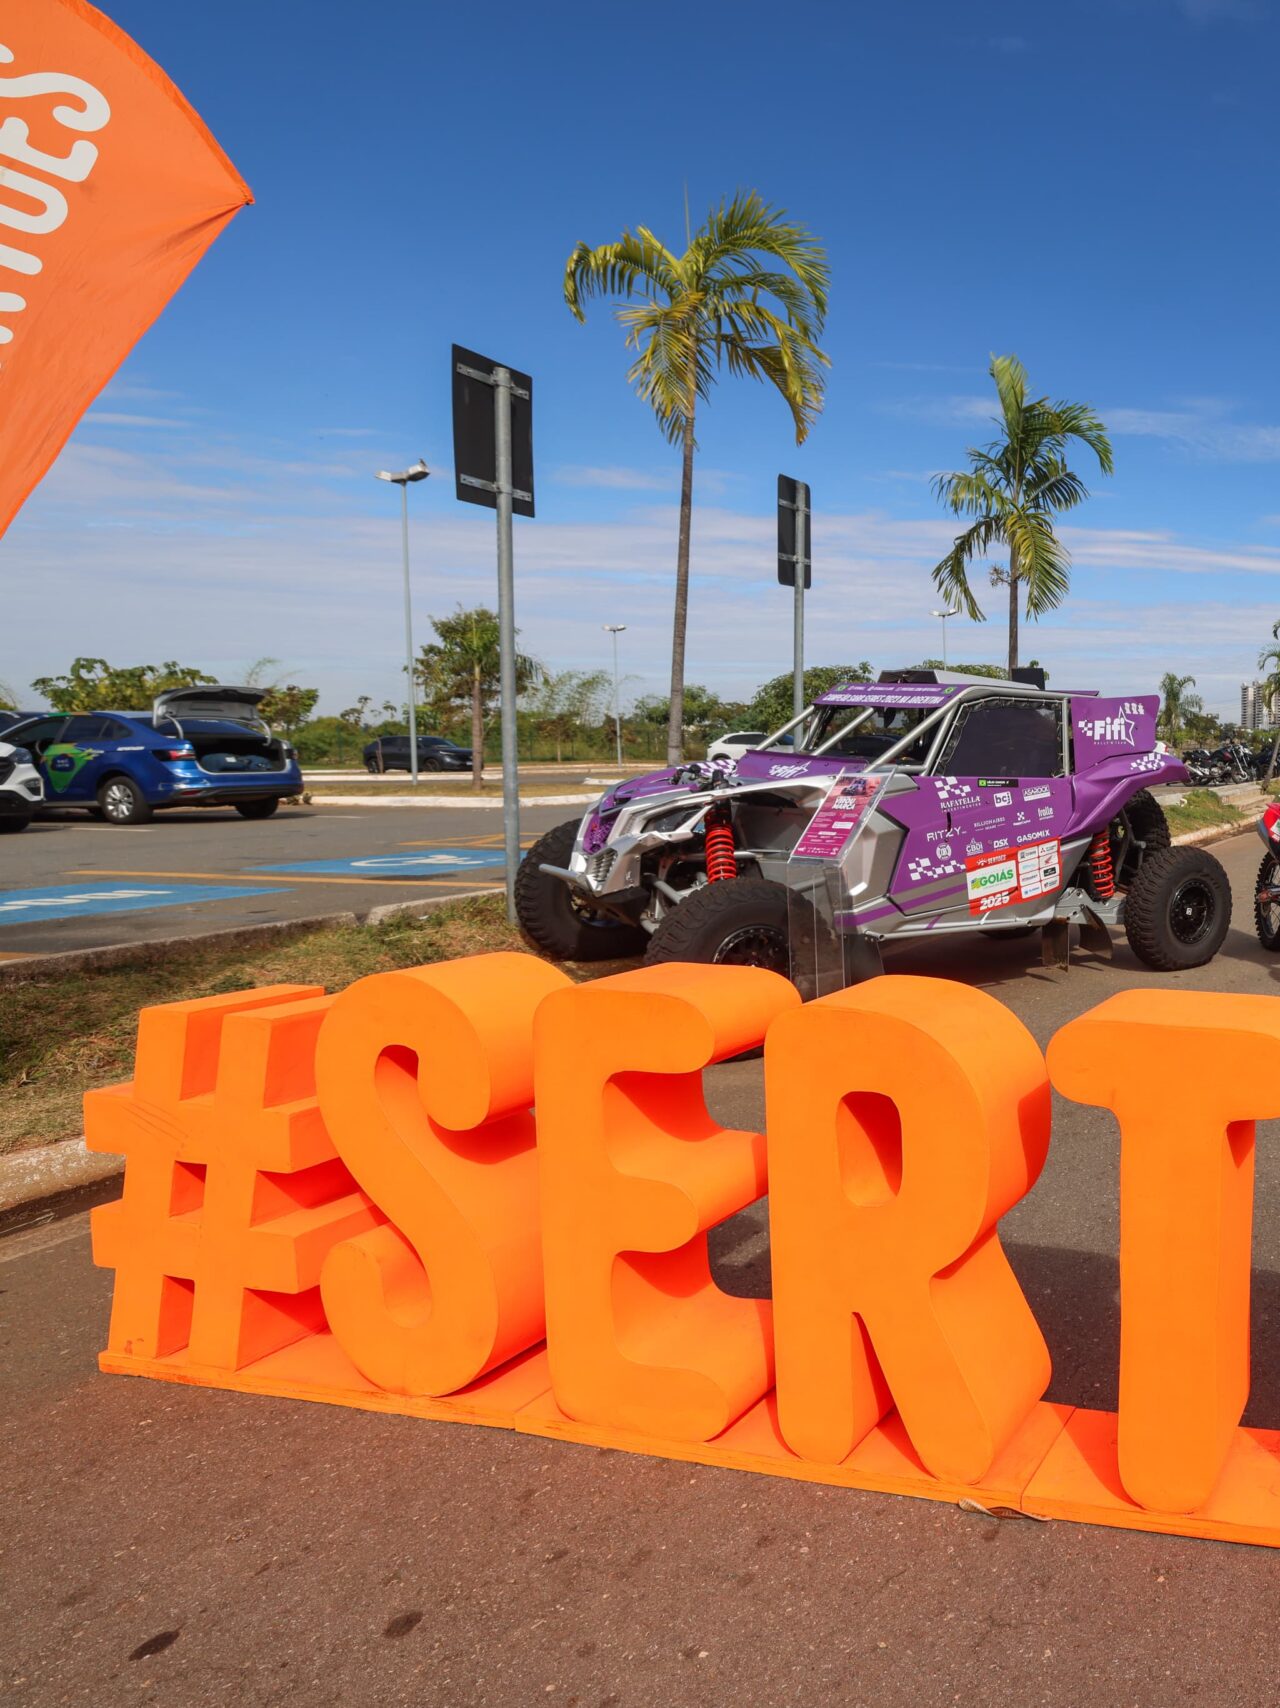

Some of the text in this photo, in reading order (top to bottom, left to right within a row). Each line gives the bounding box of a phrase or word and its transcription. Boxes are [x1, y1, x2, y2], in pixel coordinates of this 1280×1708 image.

[1094, 716, 1126, 740] Fifi
[940, 795, 981, 809] RAFATELLA
[994, 793, 1011, 805] bcj
[927, 827, 961, 841] RITZY
[1016, 829, 1050, 842] GASOMIX
[980, 868, 1014, 887] GOIÁS
[980, 891, 1010, 910] 2025
